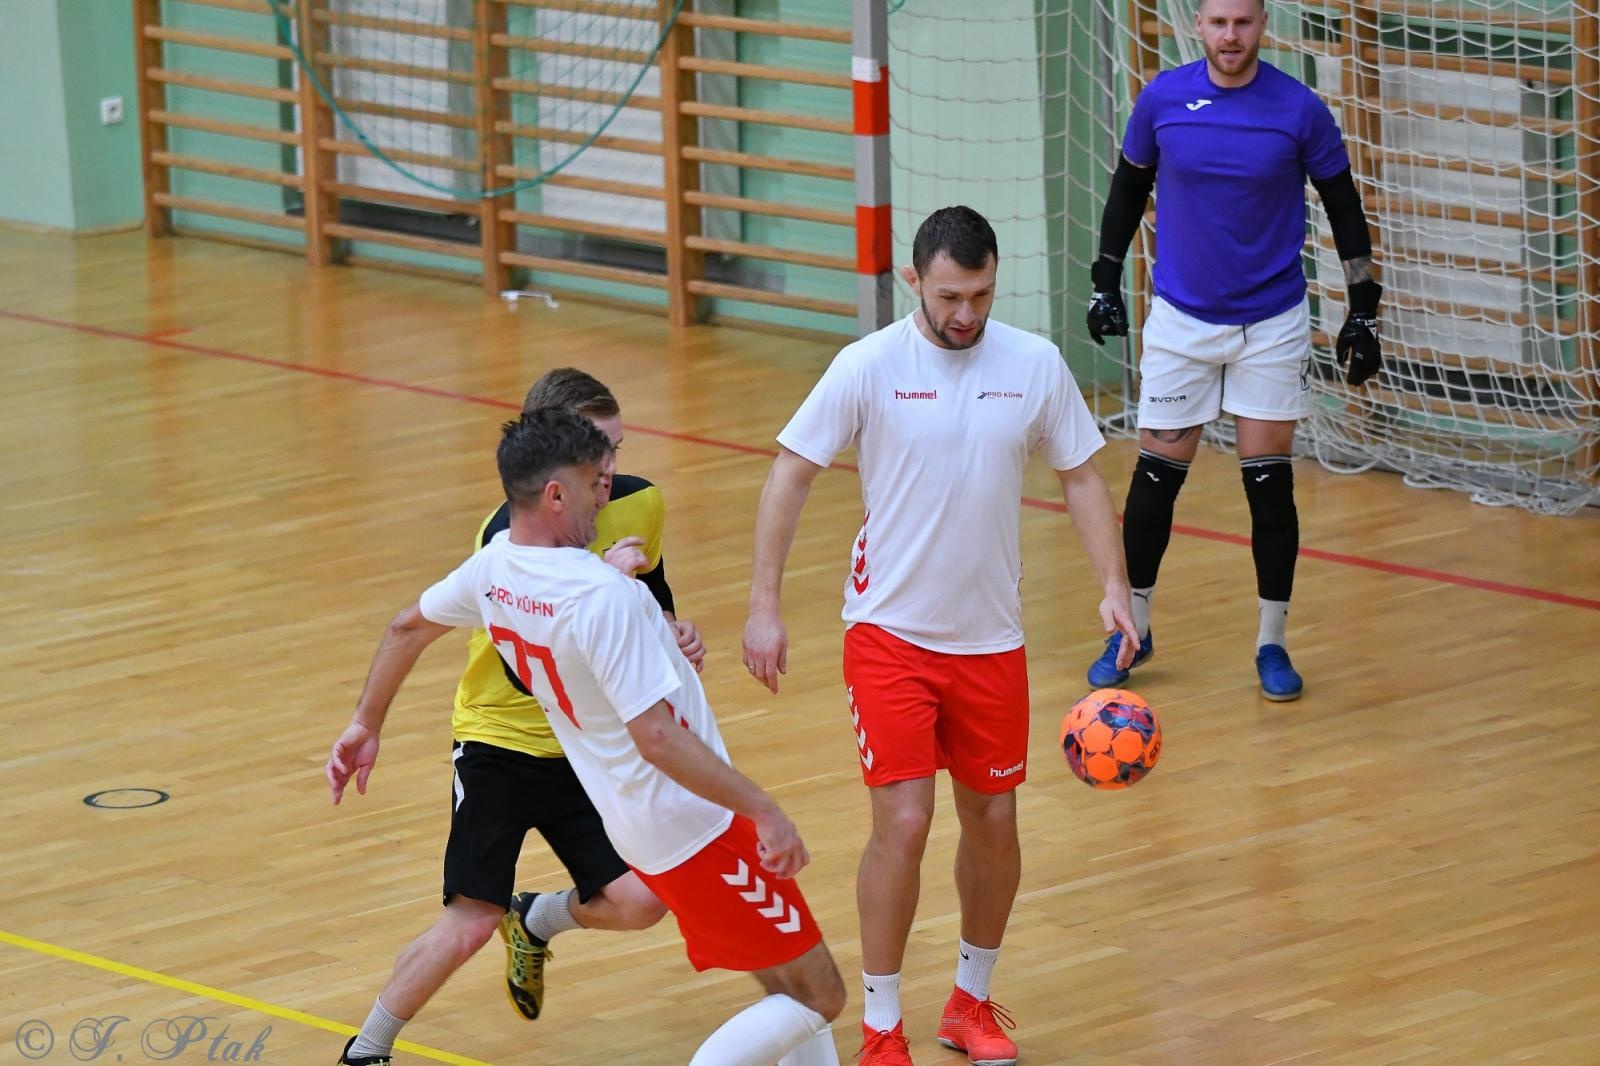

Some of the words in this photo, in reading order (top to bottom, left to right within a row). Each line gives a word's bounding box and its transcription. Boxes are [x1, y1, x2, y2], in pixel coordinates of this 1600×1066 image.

[895, 389, 937, 400] hummel
[489, 622, 583, 731] 77
[989, 760, 1024, 777] hummel
